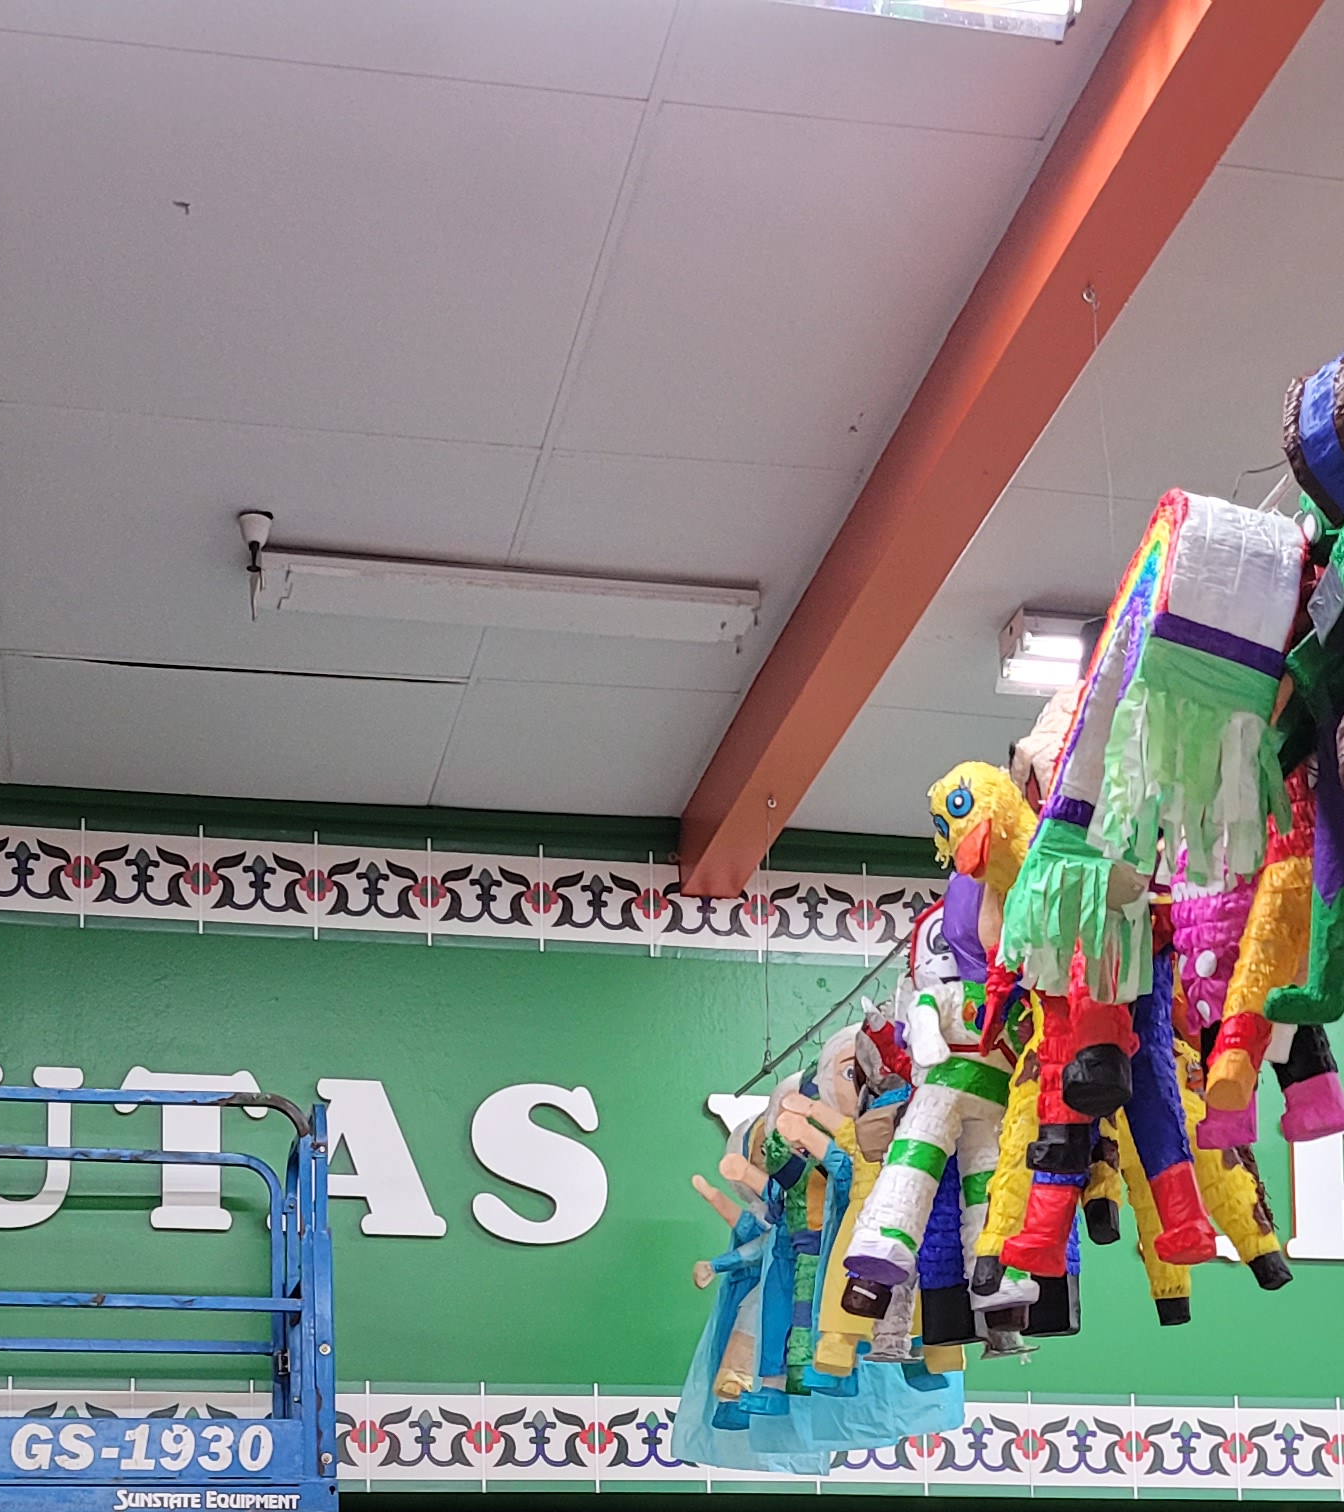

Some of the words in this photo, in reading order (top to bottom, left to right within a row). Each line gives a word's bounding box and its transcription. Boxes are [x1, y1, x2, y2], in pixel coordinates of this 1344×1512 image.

[11, 1422, 274, 1472] GS-1930
[113, 1489, 202, 1511] SUNSTATE
[205, 1490, 301, 1511] EQUIPMENT
